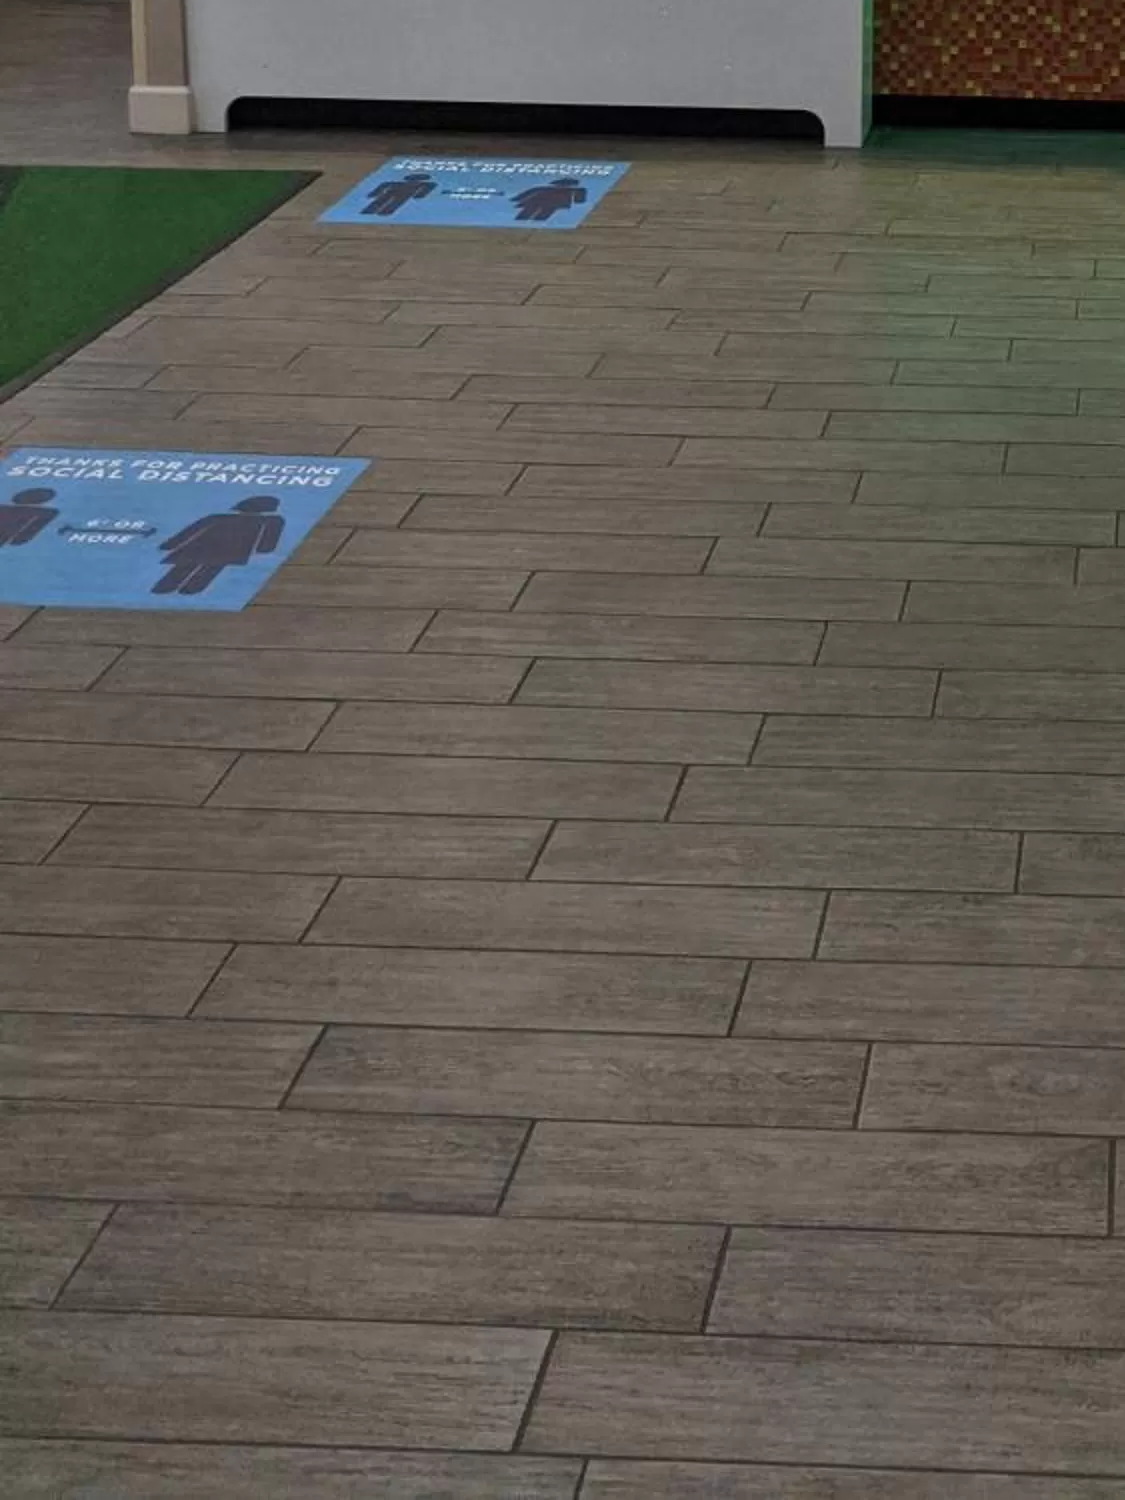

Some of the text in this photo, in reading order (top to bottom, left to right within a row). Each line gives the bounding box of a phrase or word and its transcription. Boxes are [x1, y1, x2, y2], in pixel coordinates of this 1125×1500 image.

[25, 455, 341, 475] THANKS FOR PRACTICING
[6, 465, 334, 488] SOCIAL DISTANCING
